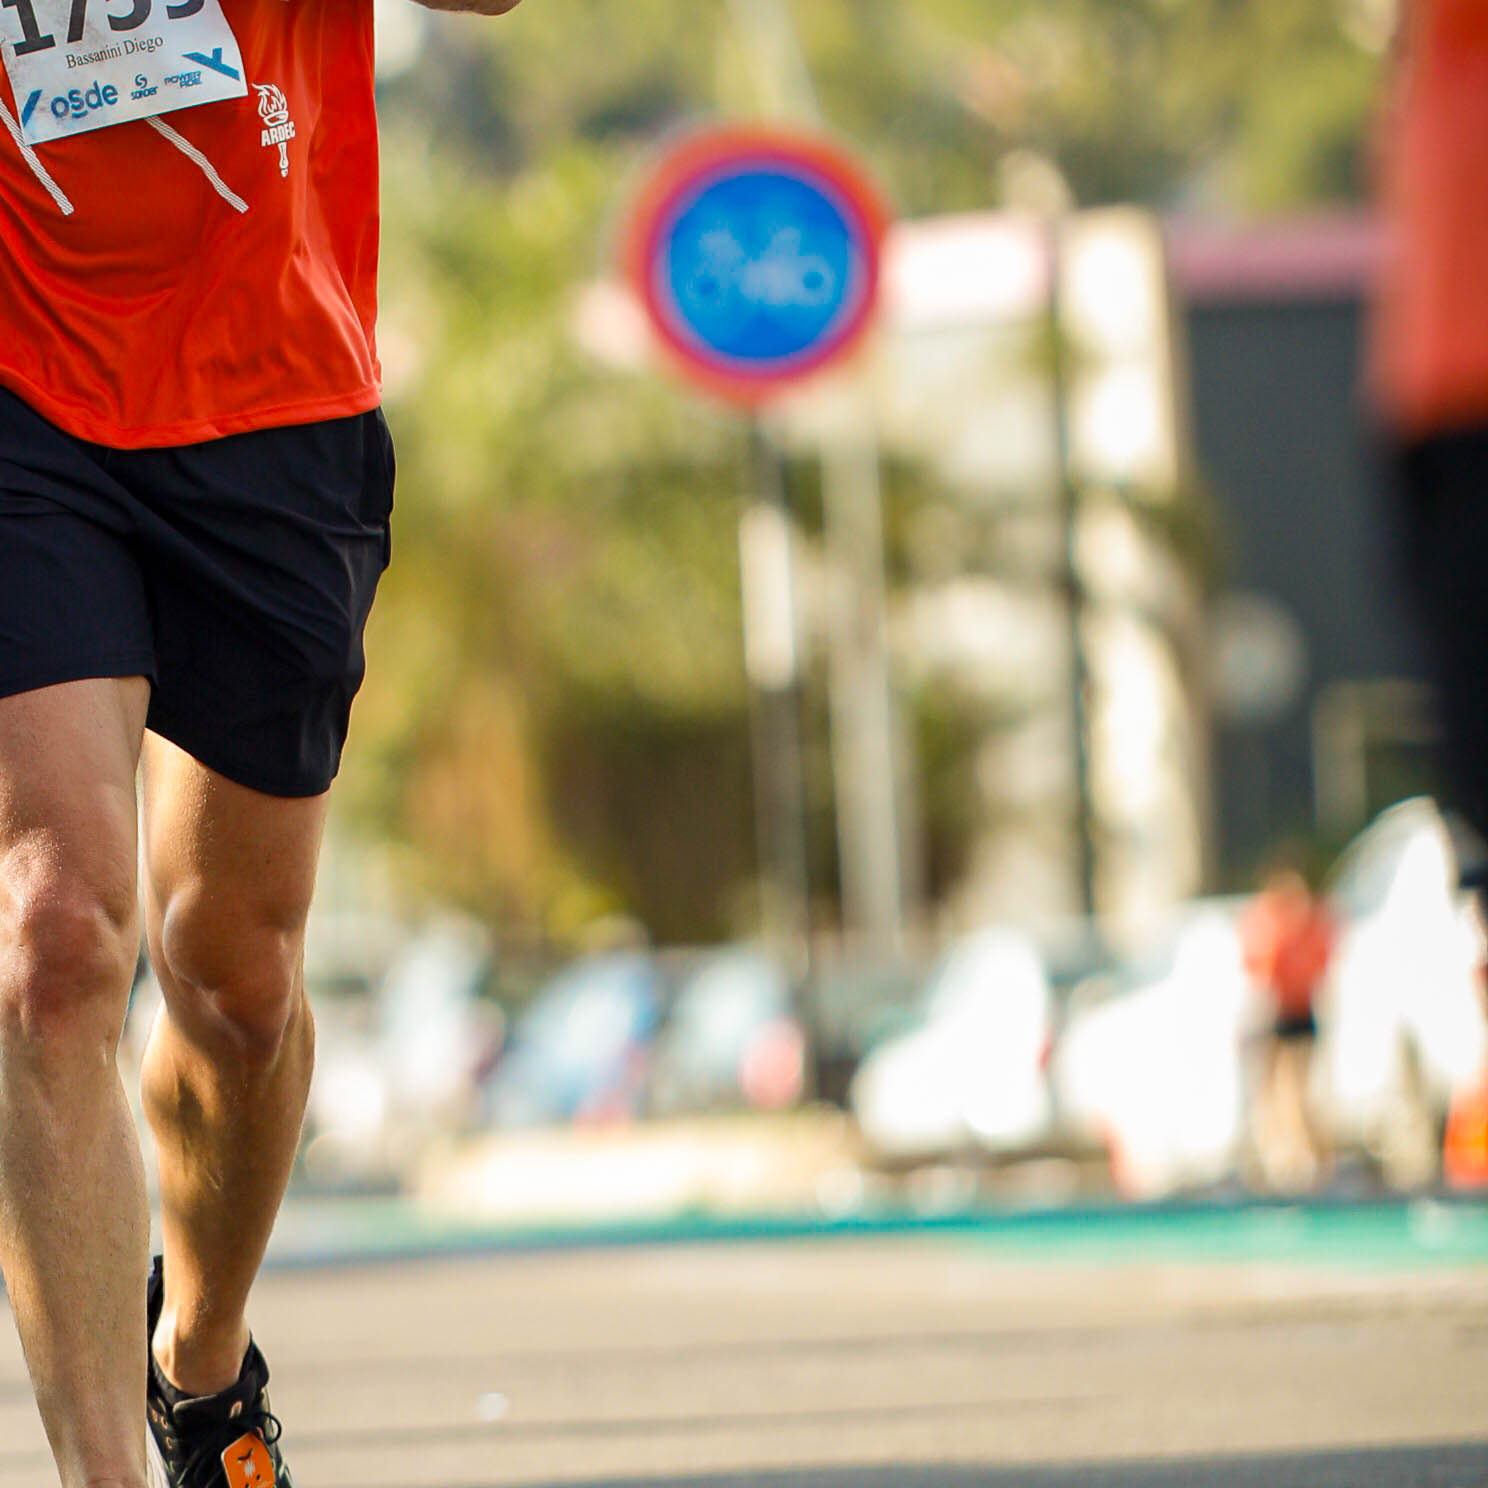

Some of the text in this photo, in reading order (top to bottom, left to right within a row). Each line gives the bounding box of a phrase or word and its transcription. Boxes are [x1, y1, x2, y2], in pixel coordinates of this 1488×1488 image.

[65, 36, 164, 69] Bassanini Diego
[50, 80, 119, 118] osde
[261, 120, 296, 147] ARDEC
